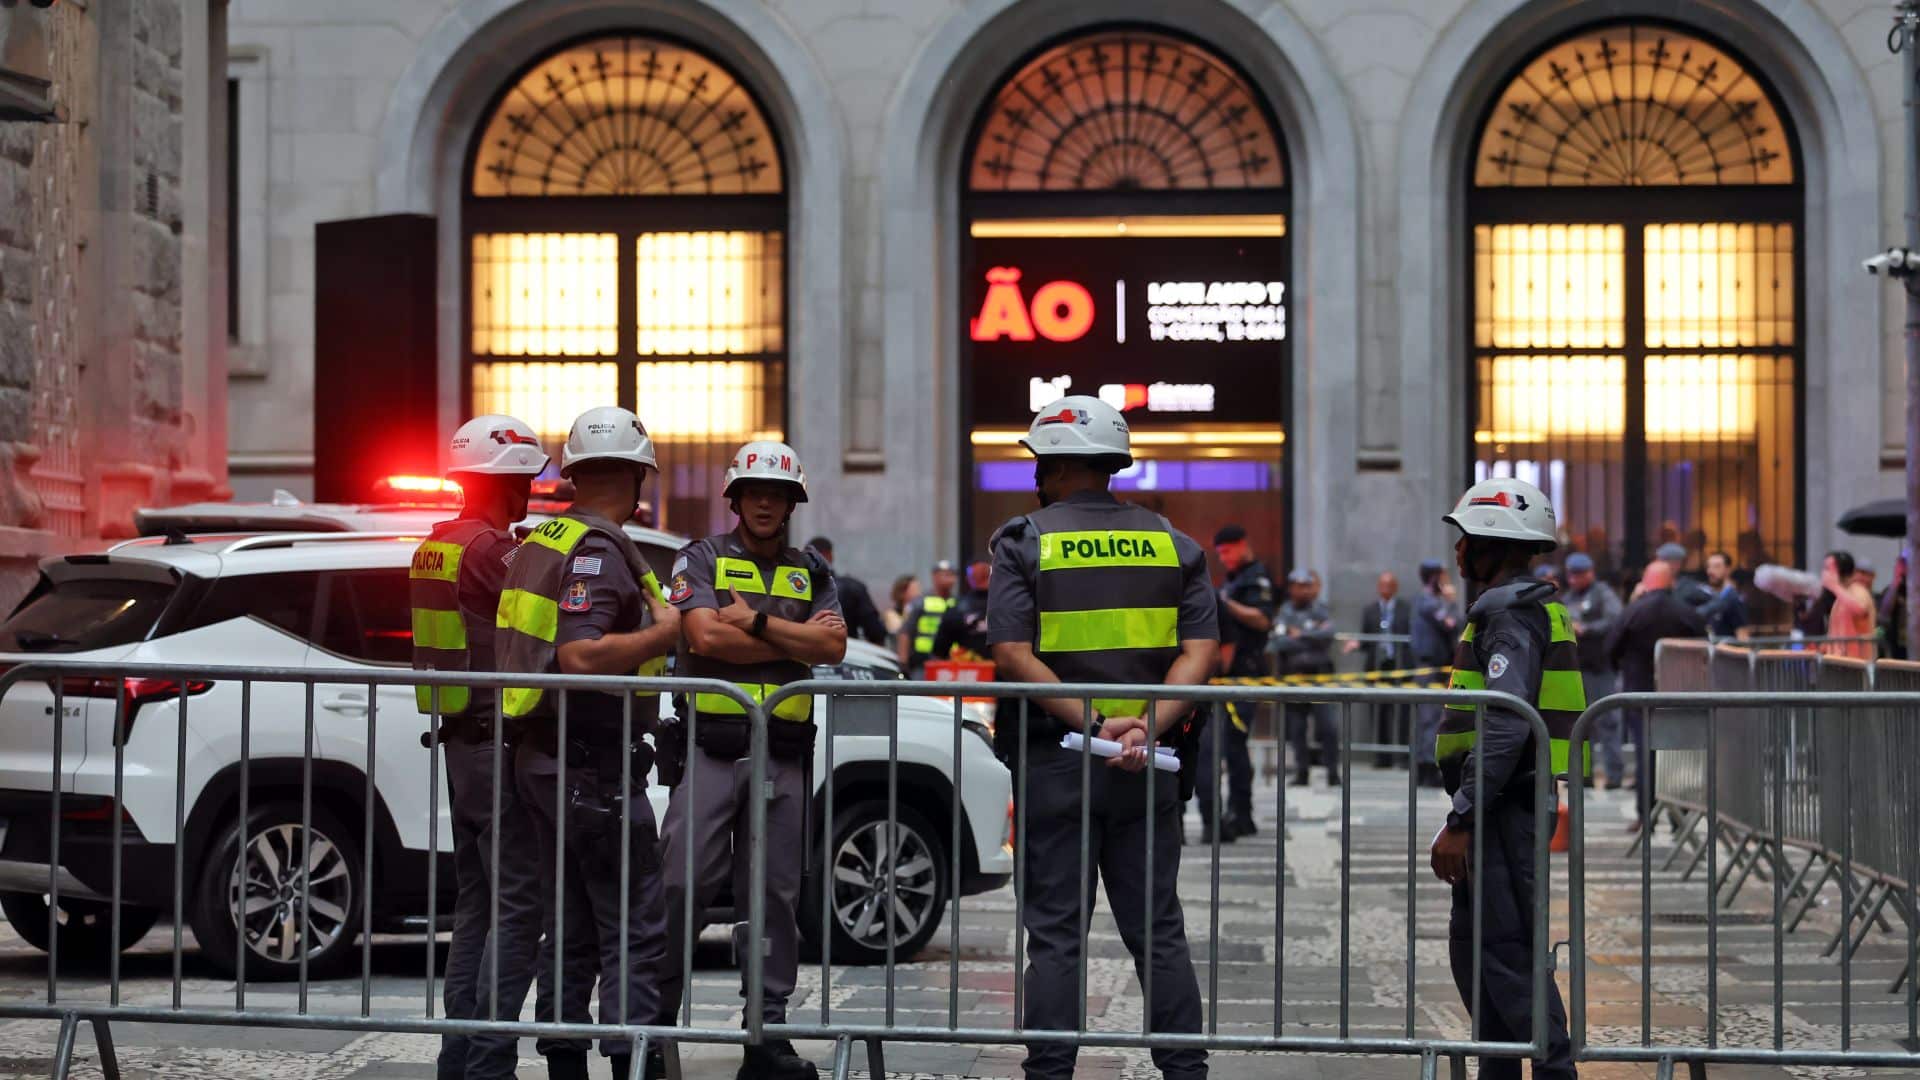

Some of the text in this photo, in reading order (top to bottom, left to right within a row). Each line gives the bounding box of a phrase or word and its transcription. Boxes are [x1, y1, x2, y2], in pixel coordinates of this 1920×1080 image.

[970, 266, 1095, 342] ÃO
[746, 453, 791, 473] P M
[1061, 534, 1157, 559] POLÍCIA
